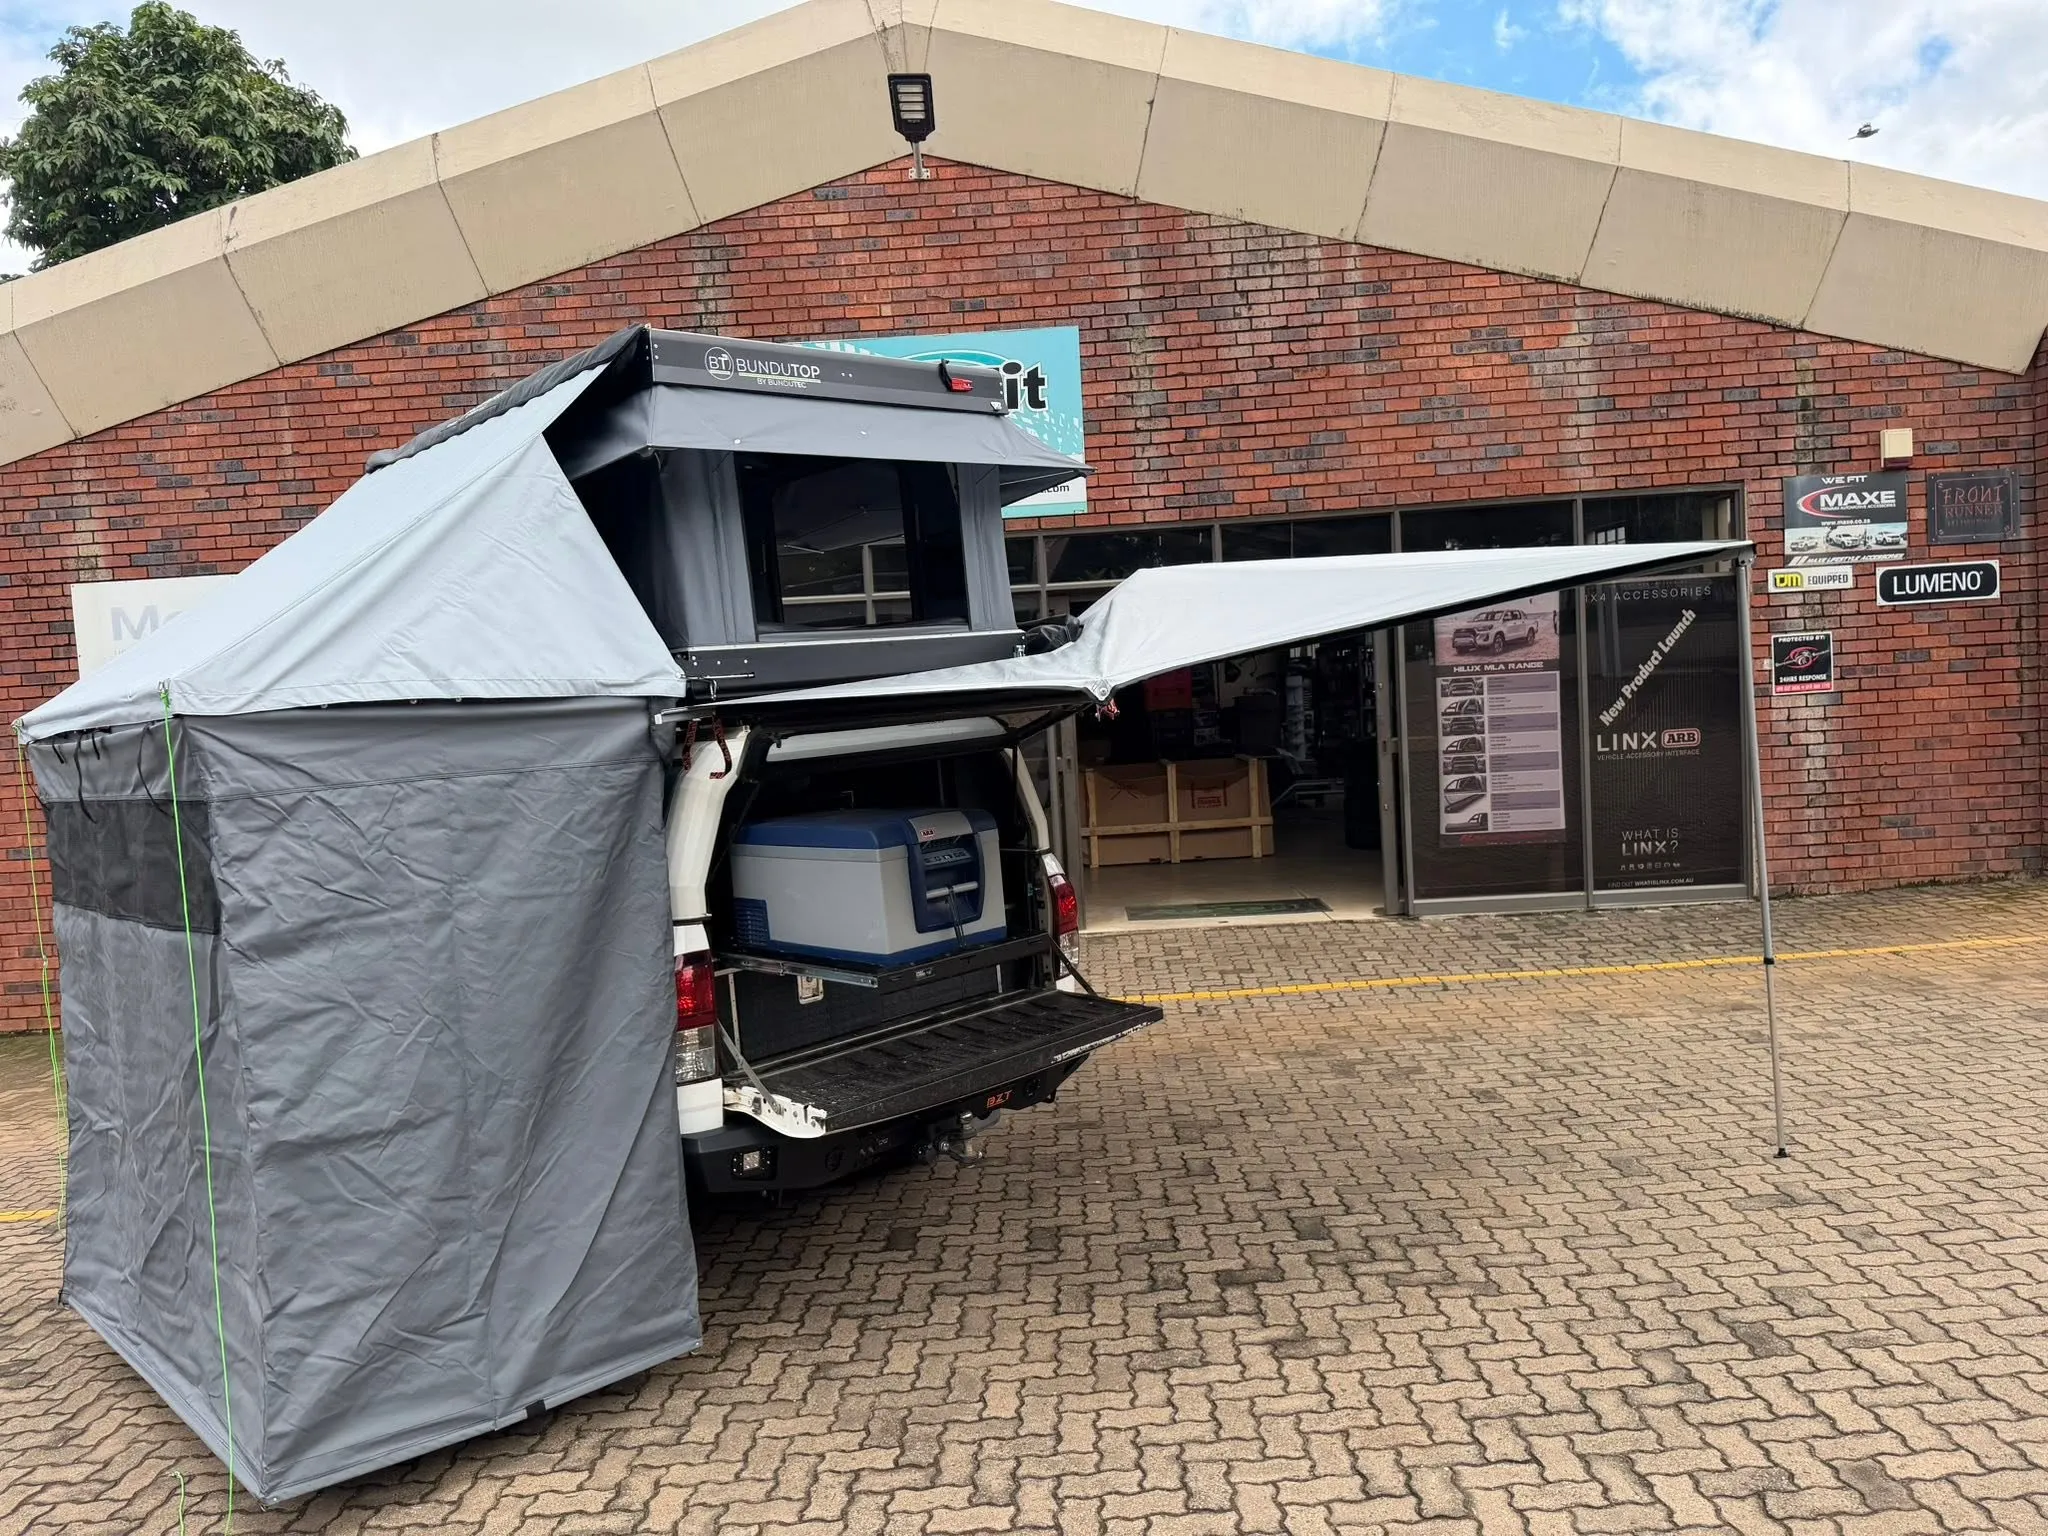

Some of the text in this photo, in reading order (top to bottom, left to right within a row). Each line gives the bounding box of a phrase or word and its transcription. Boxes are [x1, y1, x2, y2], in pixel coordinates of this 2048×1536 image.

[736, 358, 820, 378] BUNDUTOP
[997, 361, 1048, 411] it
[1847, 475, 1868, 483] FIT
[1040, 484, 1070, 494] .com
[1942, 485, 2004, 505] FRONT
[1820, 490, 1896, 507] MAXE
[1945, 503, 2003, 518] RUNNER
[1808, 574, 1848, 585] EQUIPPED
[1893, 571, 1981, 595] LUMENO
[1615, 586, 1711, 600] ACCESSORIES
[1599, 697, 1627, 727] New
[1621, 650, 1663, 699] Product
[1657, 608, 1697, 653] Launch
[1798, 674, 1827, 682] RESPONSE
[1597, 731, 1697, 752] LINX ARB
[1597, 753, 1624, 761] VEHICLE
[1626, 751, 1664, 759] ACCESSORY
[1622, 828, 1679, 841] WHAT IS
